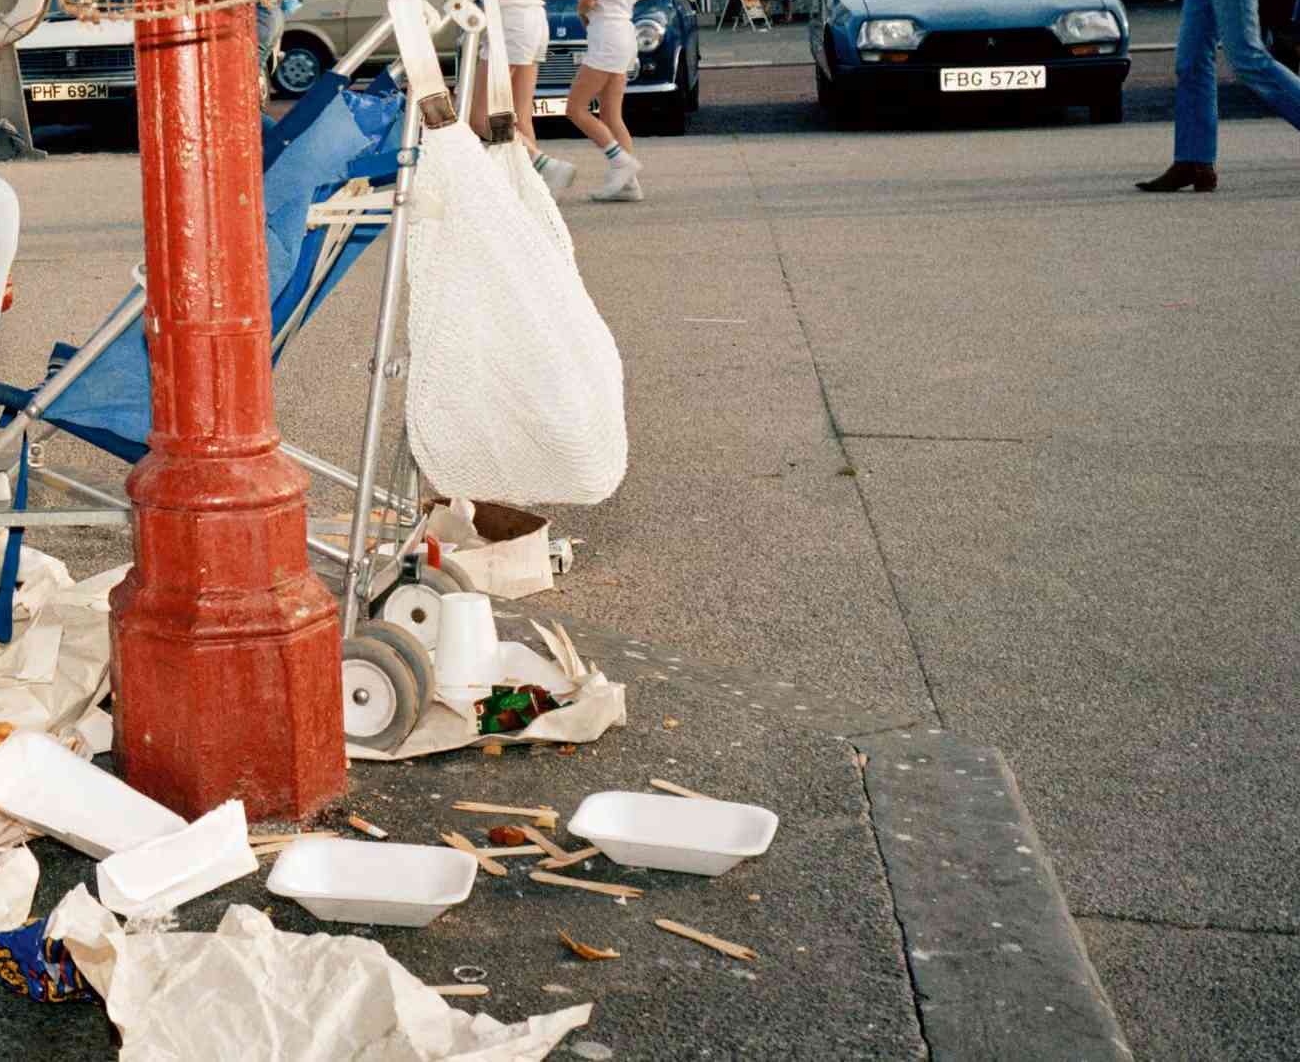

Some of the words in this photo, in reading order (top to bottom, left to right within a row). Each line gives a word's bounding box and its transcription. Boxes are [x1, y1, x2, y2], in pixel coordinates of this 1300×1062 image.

[944, 71, 982, 87] FBG
[990, 69, 1041, 86] 572Y
[33, 85, 61, 99] PHF
[67, 82, 107, 98] 692M
